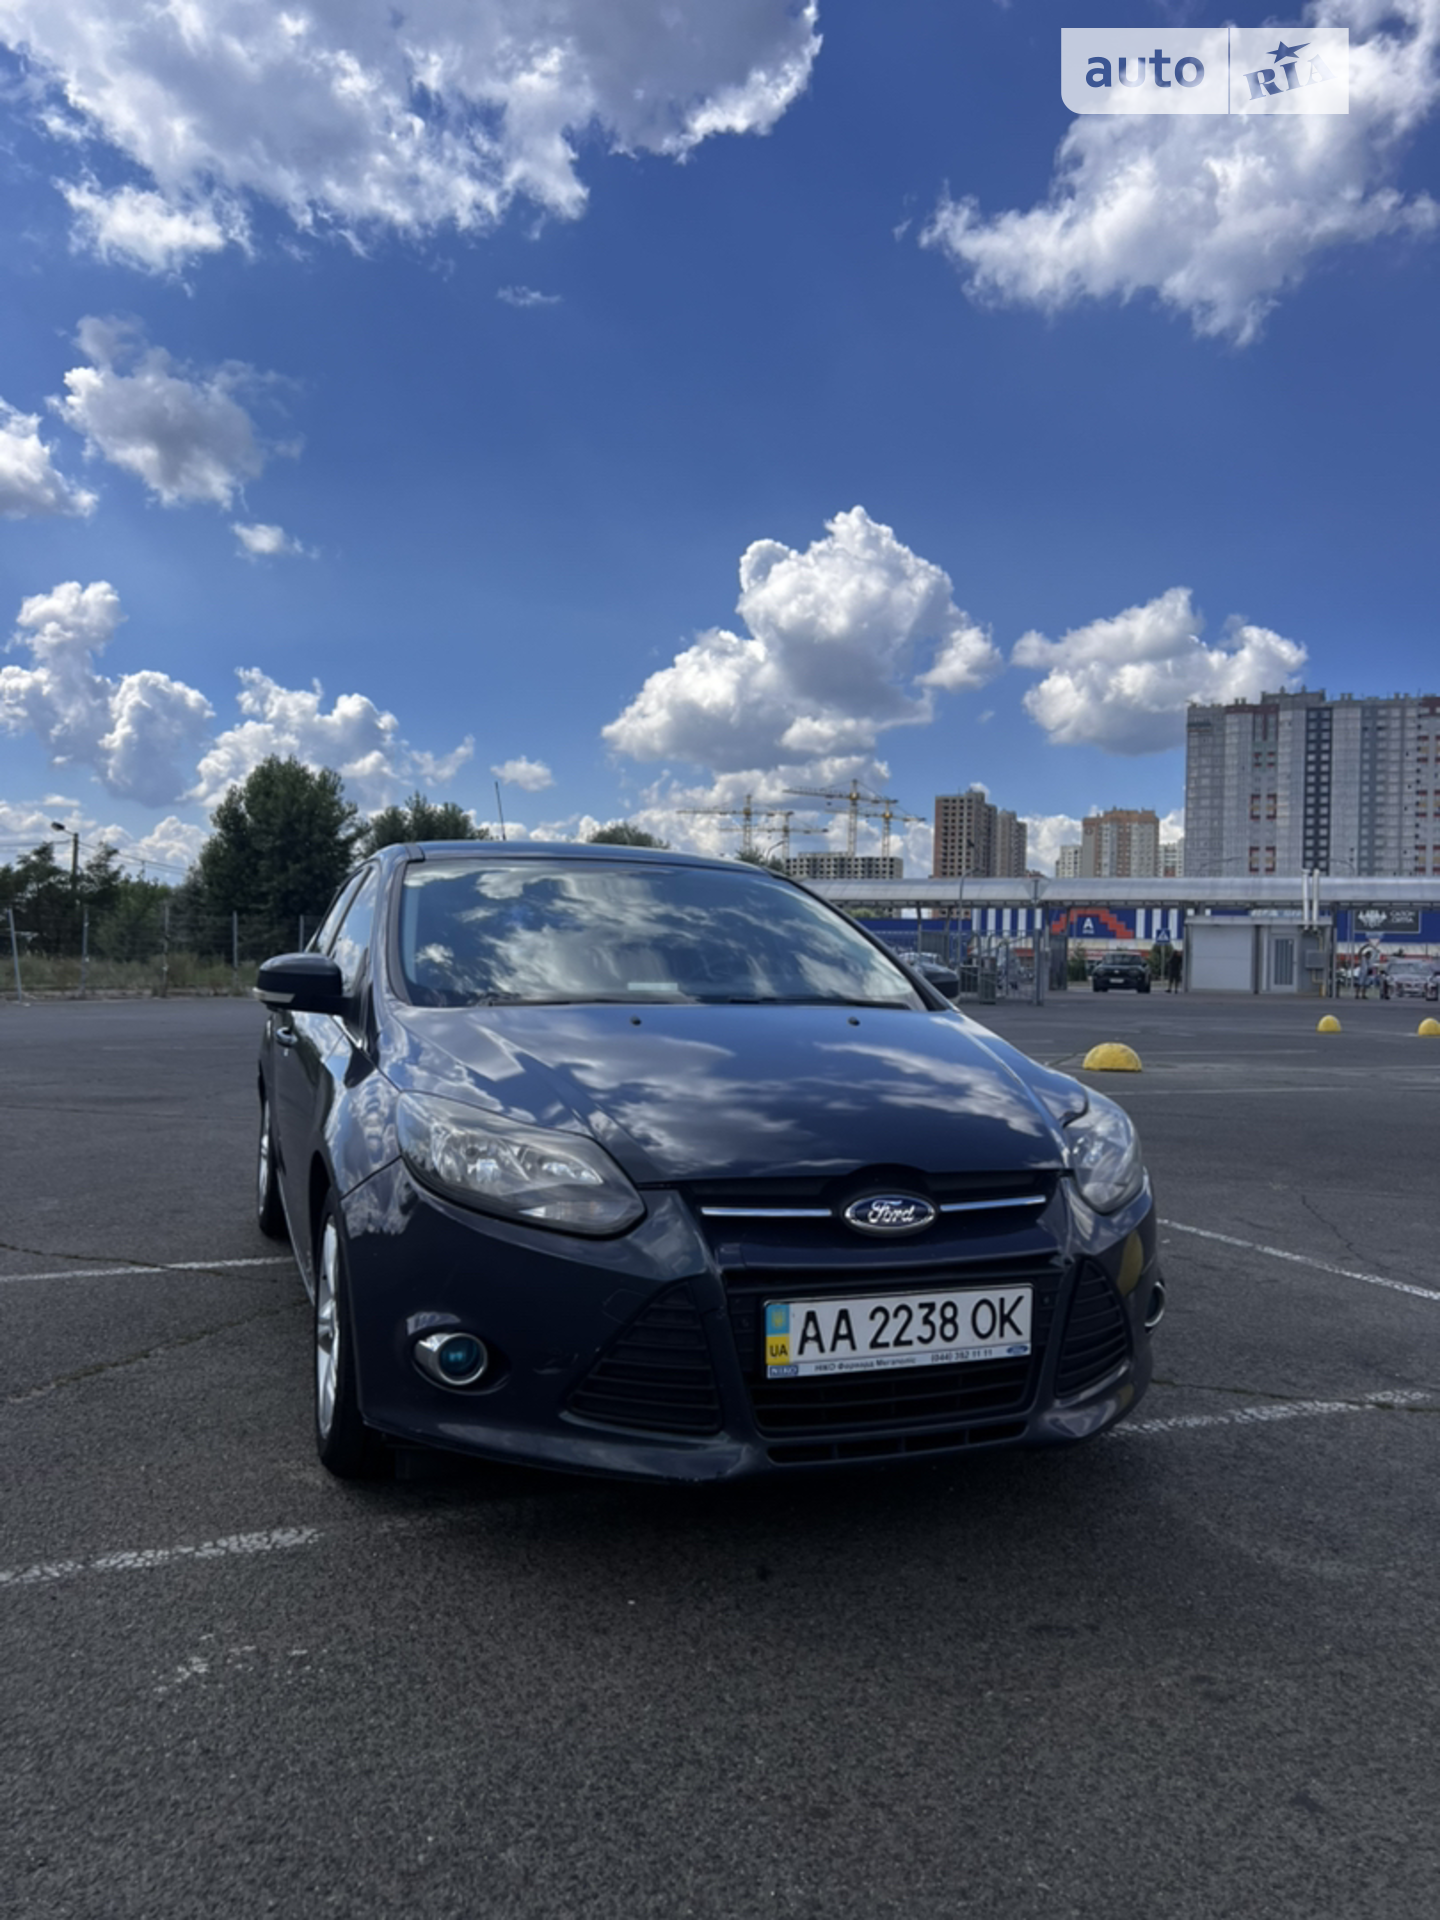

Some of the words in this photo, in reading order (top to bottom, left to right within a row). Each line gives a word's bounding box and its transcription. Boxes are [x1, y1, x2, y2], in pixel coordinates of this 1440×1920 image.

[867, 1199, 916, 1224] Ford
[797, 1308, 858, 1356] AA
[868, 1300, 959, 1350] 2238
[970, 1295, 1025, 1341] OK
[769, 1345, 788, 1358] UA
